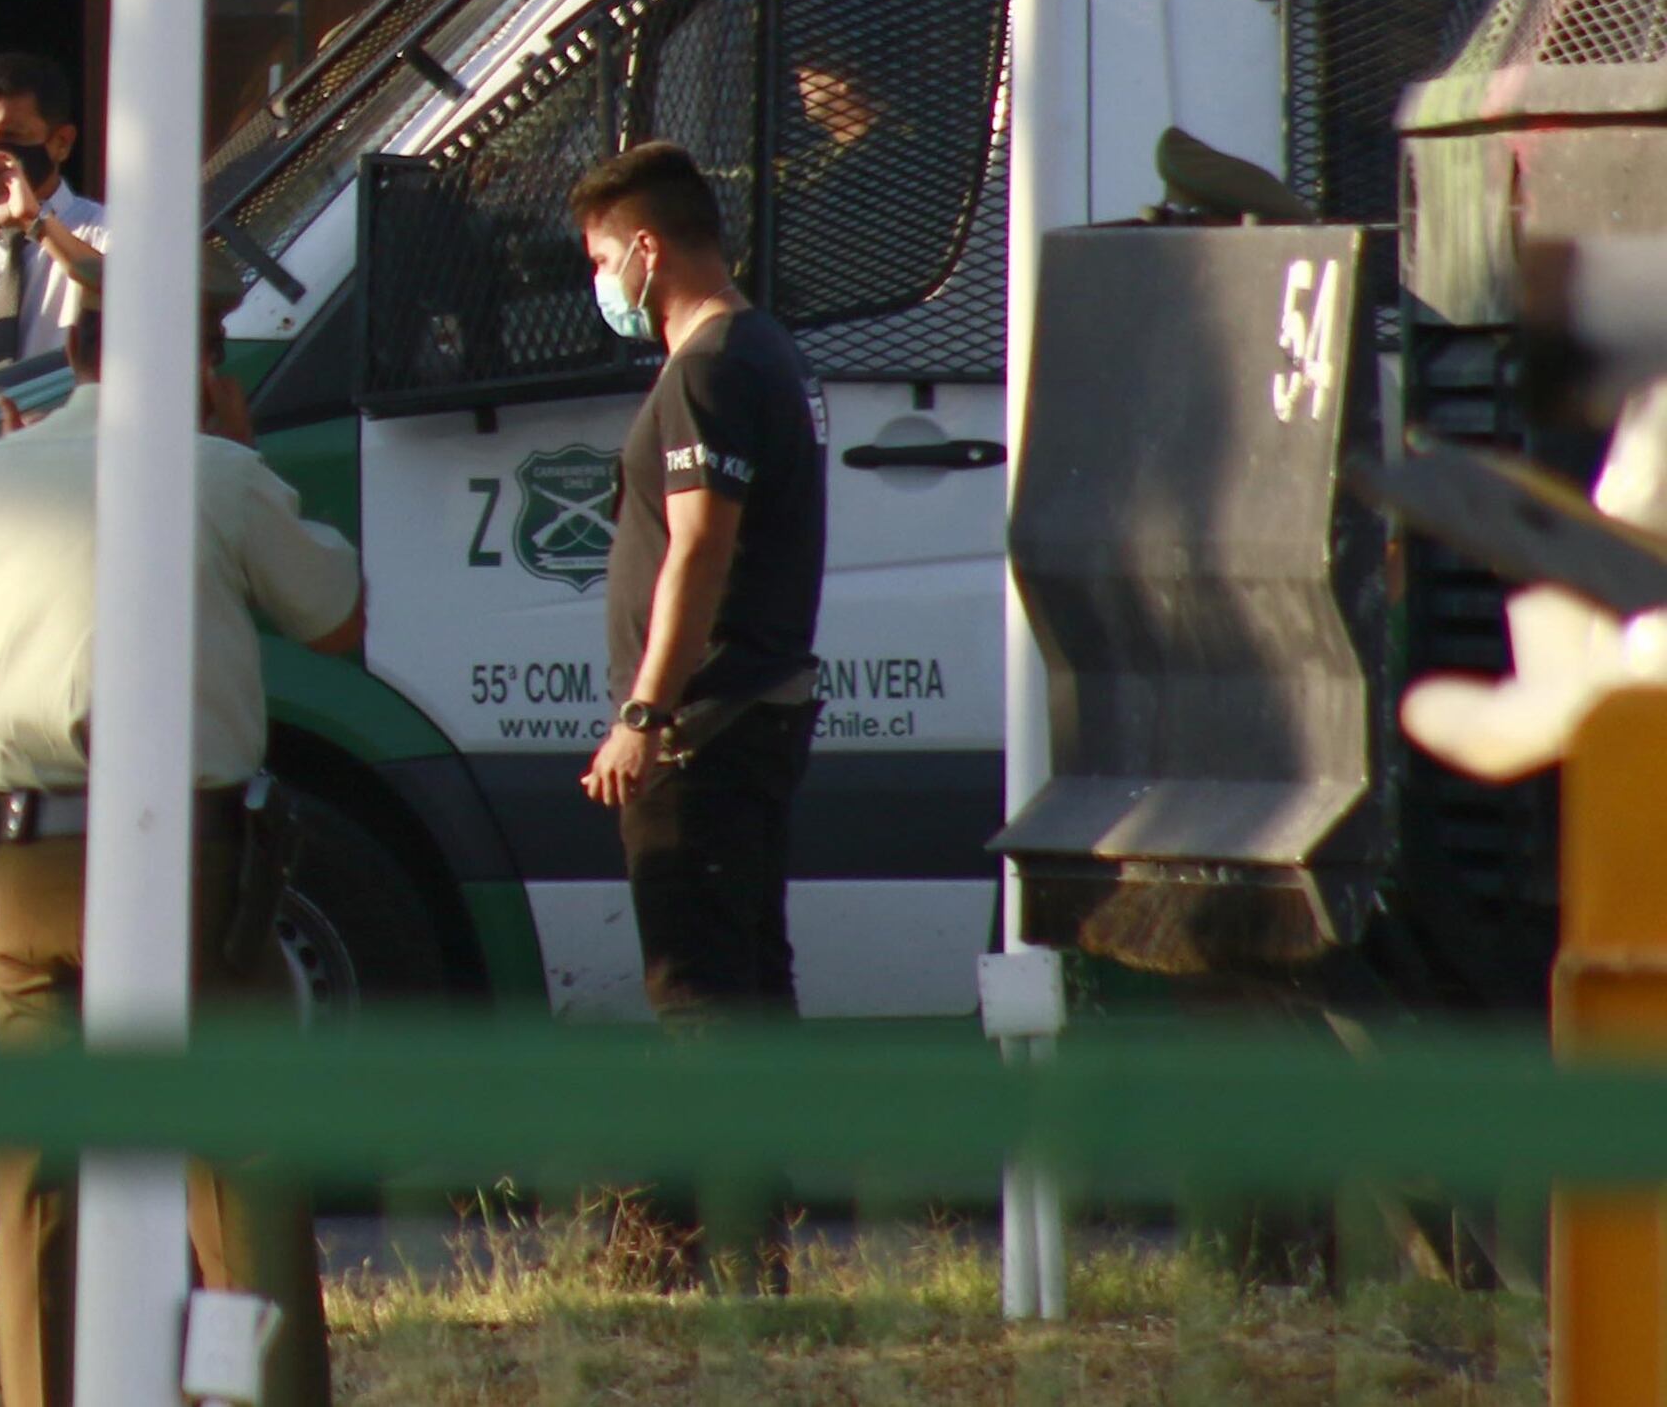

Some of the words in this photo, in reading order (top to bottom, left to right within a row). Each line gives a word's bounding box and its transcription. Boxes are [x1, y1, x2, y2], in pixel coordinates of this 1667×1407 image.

[468, 478, 502, 567] Z
[524, 662, 598, 704] COM.
[865, 659, 945, 699] VERA
